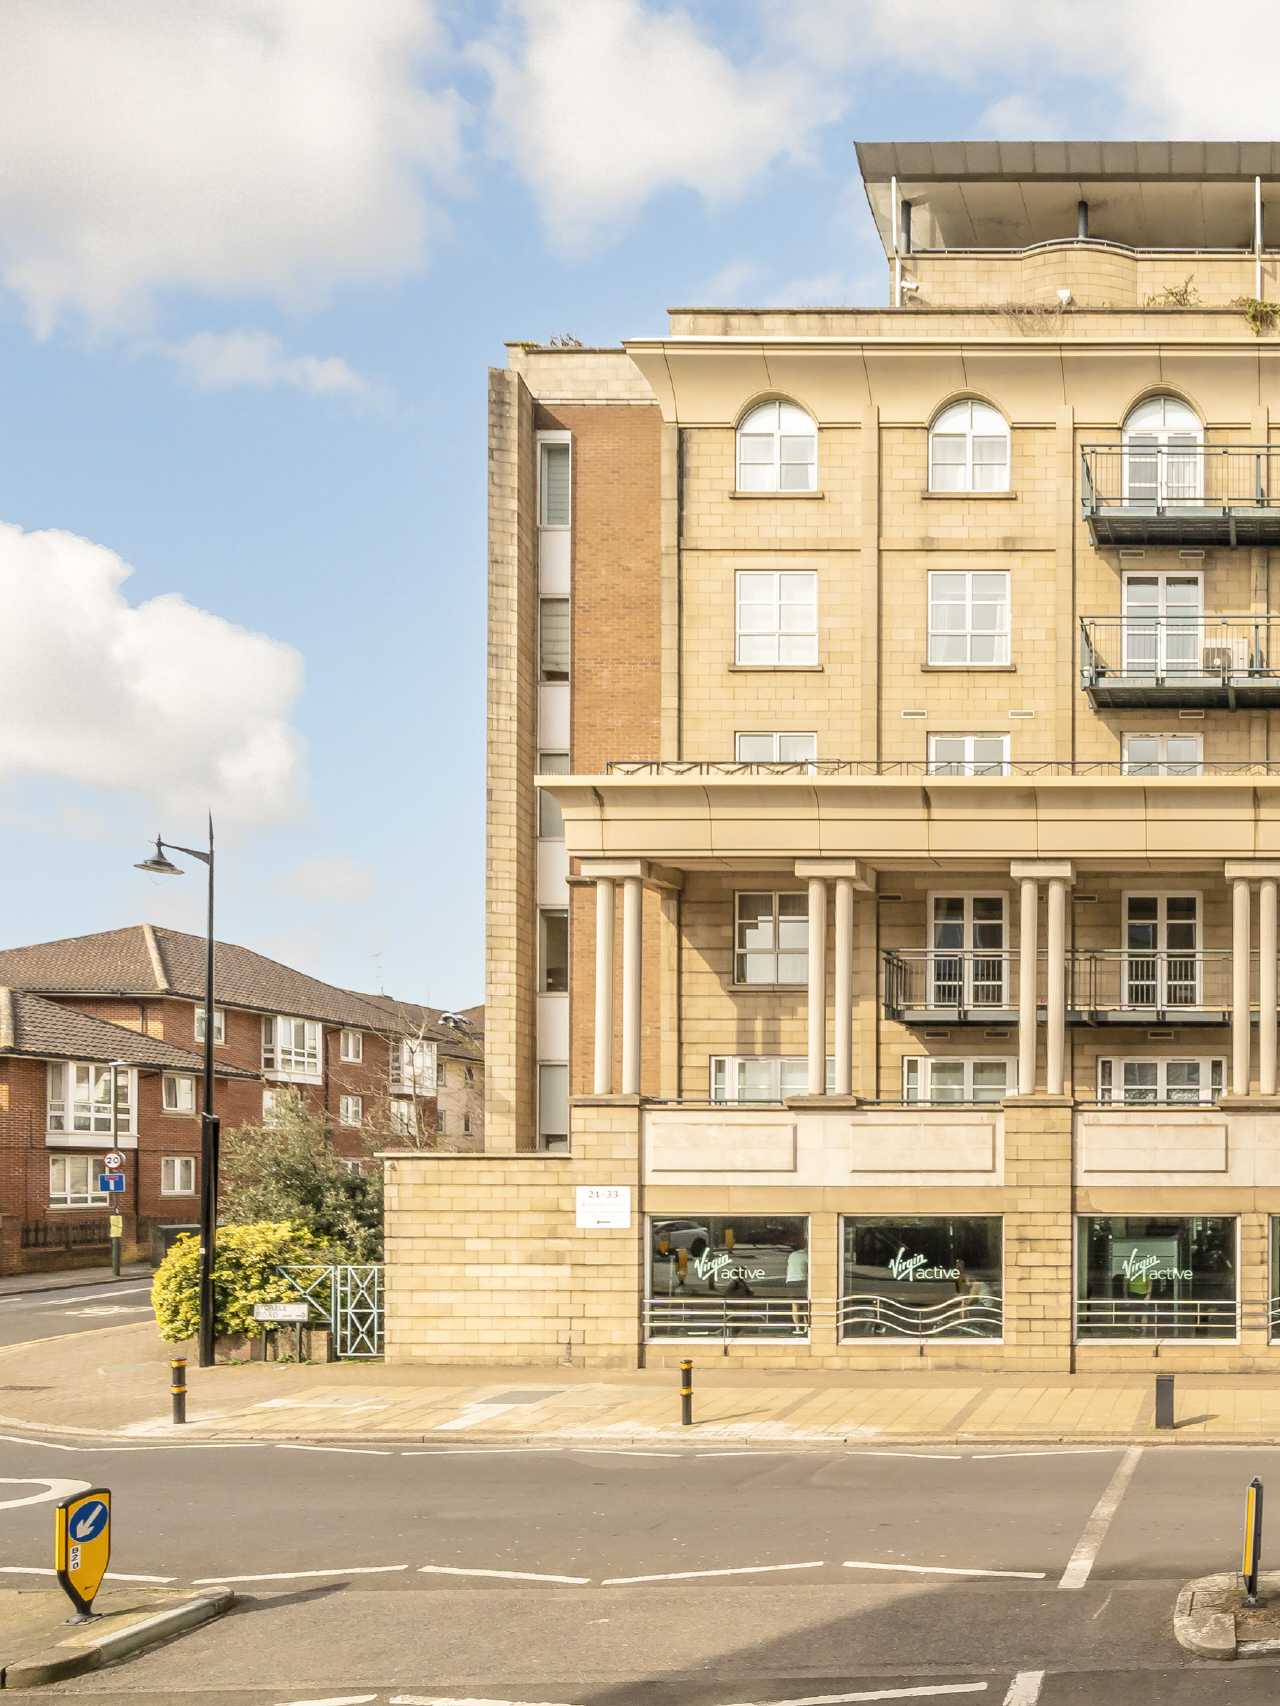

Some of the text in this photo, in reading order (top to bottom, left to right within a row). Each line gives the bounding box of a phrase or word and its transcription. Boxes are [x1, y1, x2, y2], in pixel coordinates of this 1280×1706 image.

[106, 1156, 119, 1164] 20
[694, 1247, 766, 1282] Virgin active
[888, 1247, 960, 1282] Virgin active
[1121, 1247, 1193, 1282] Virgin active
